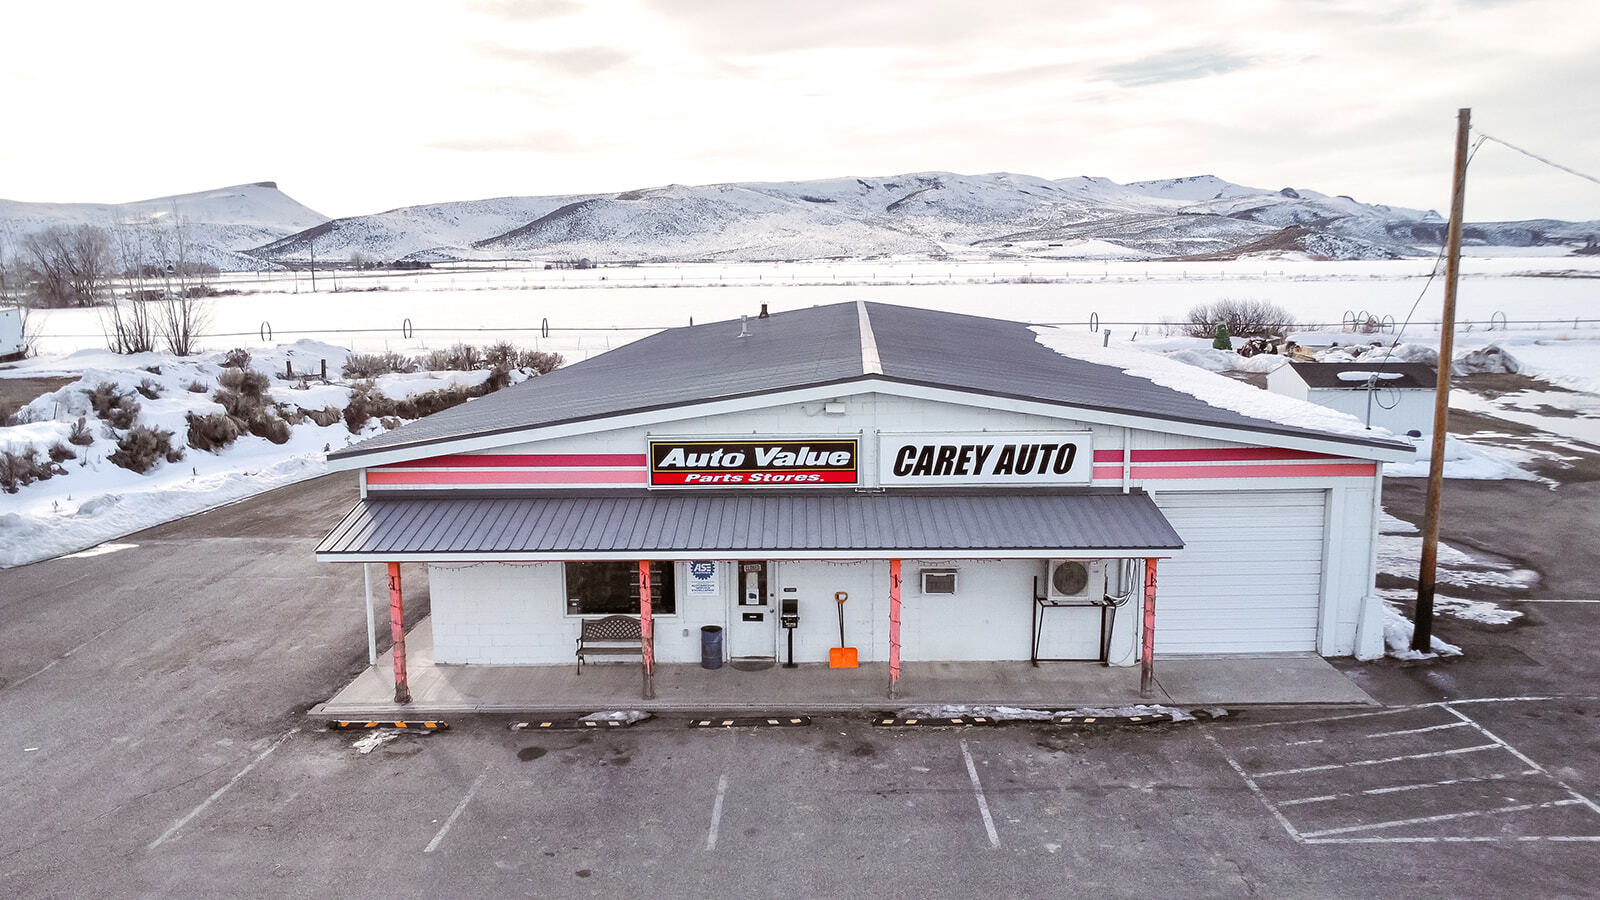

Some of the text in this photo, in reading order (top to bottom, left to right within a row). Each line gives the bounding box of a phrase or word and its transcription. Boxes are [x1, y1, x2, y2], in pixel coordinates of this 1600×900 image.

[658, 446, 851, 467] Auto Value
[893, 443, 1077, 476] CAREY AUTO
[684, 473, 825, 483] Parts Stores.
[694, 563, 712, 572] ASE
